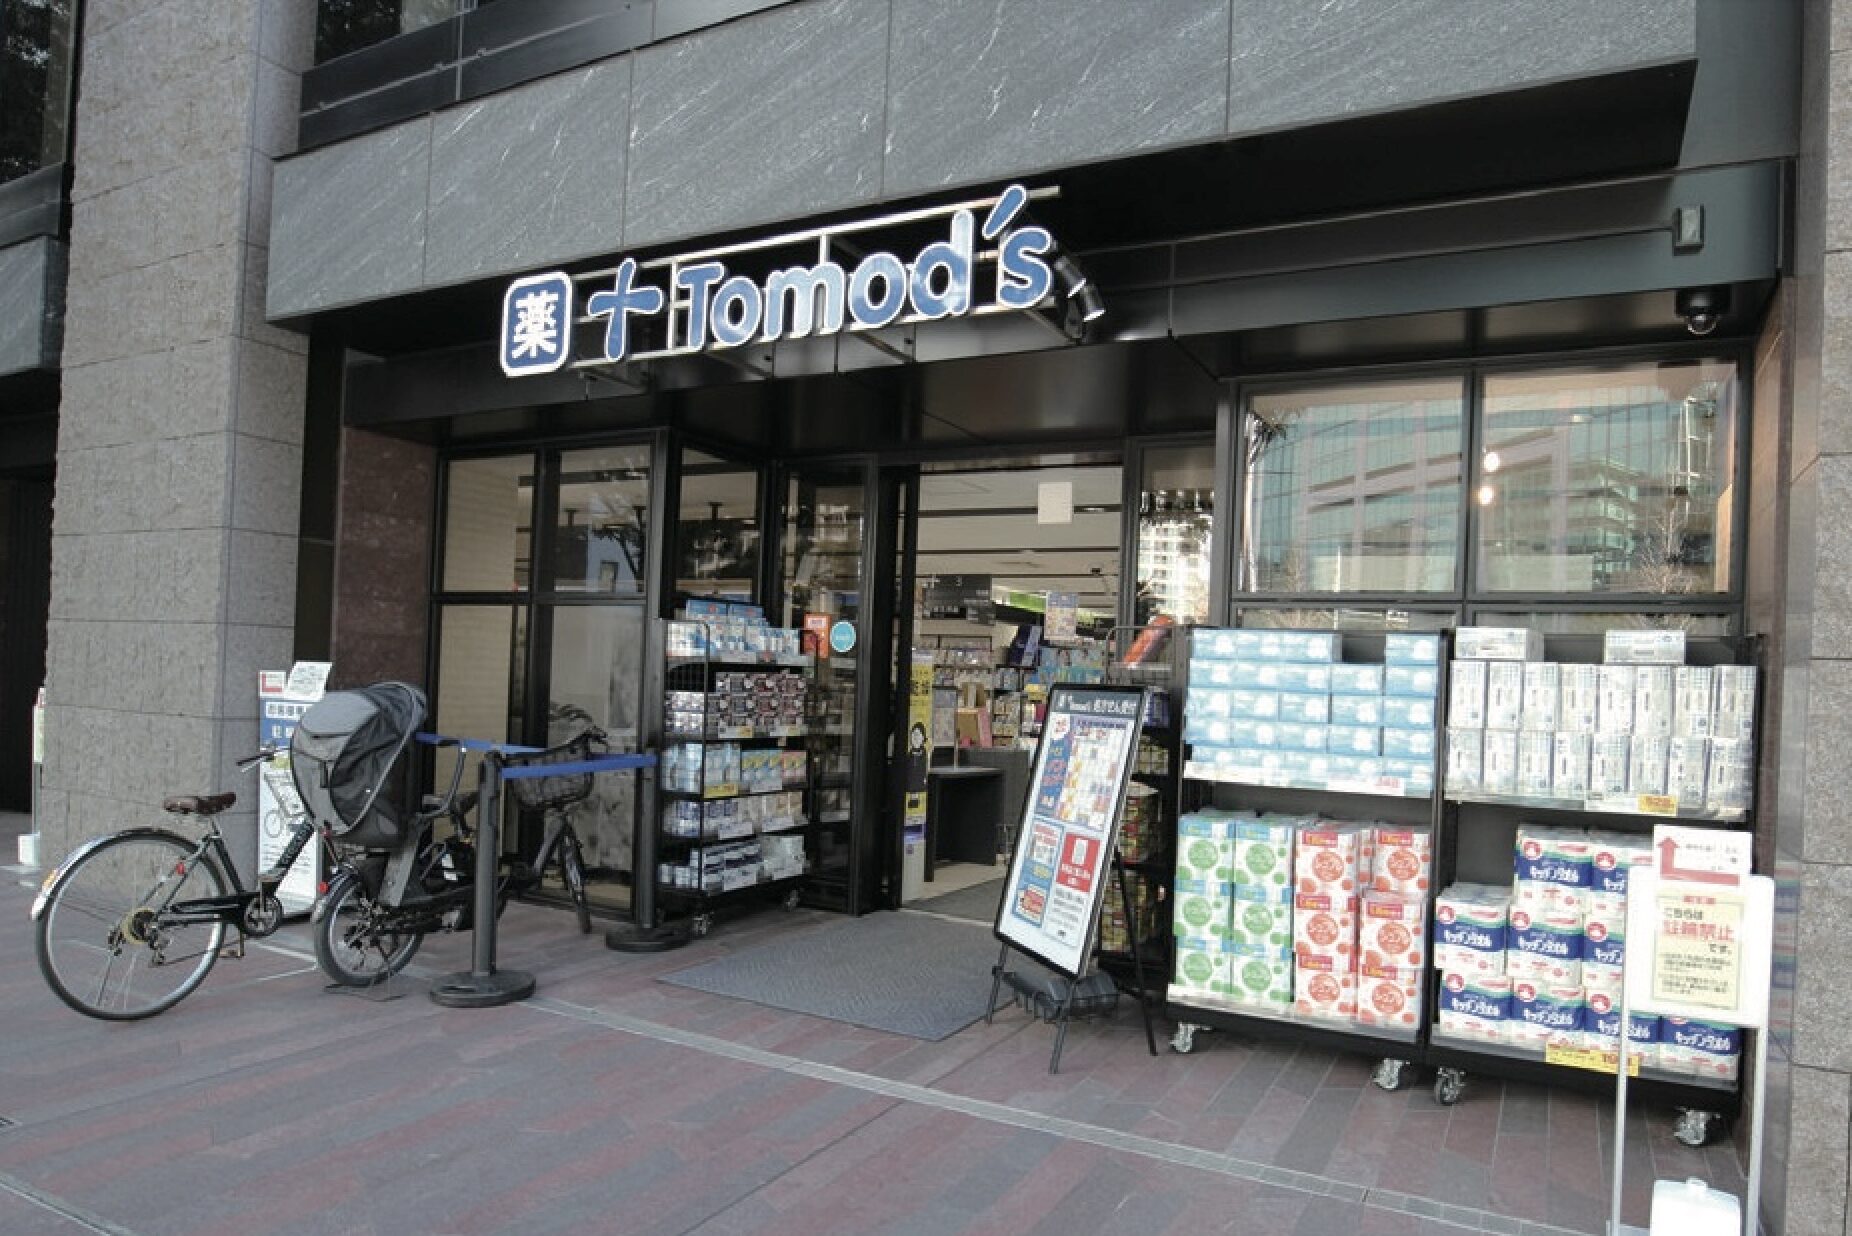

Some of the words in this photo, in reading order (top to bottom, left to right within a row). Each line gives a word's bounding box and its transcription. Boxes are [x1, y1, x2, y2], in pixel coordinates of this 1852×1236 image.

[677, 184, 1054, 353] Tomod's
[512, 289, 559, 359] 薬
[1663, 907, 1703, 921] こちらは
